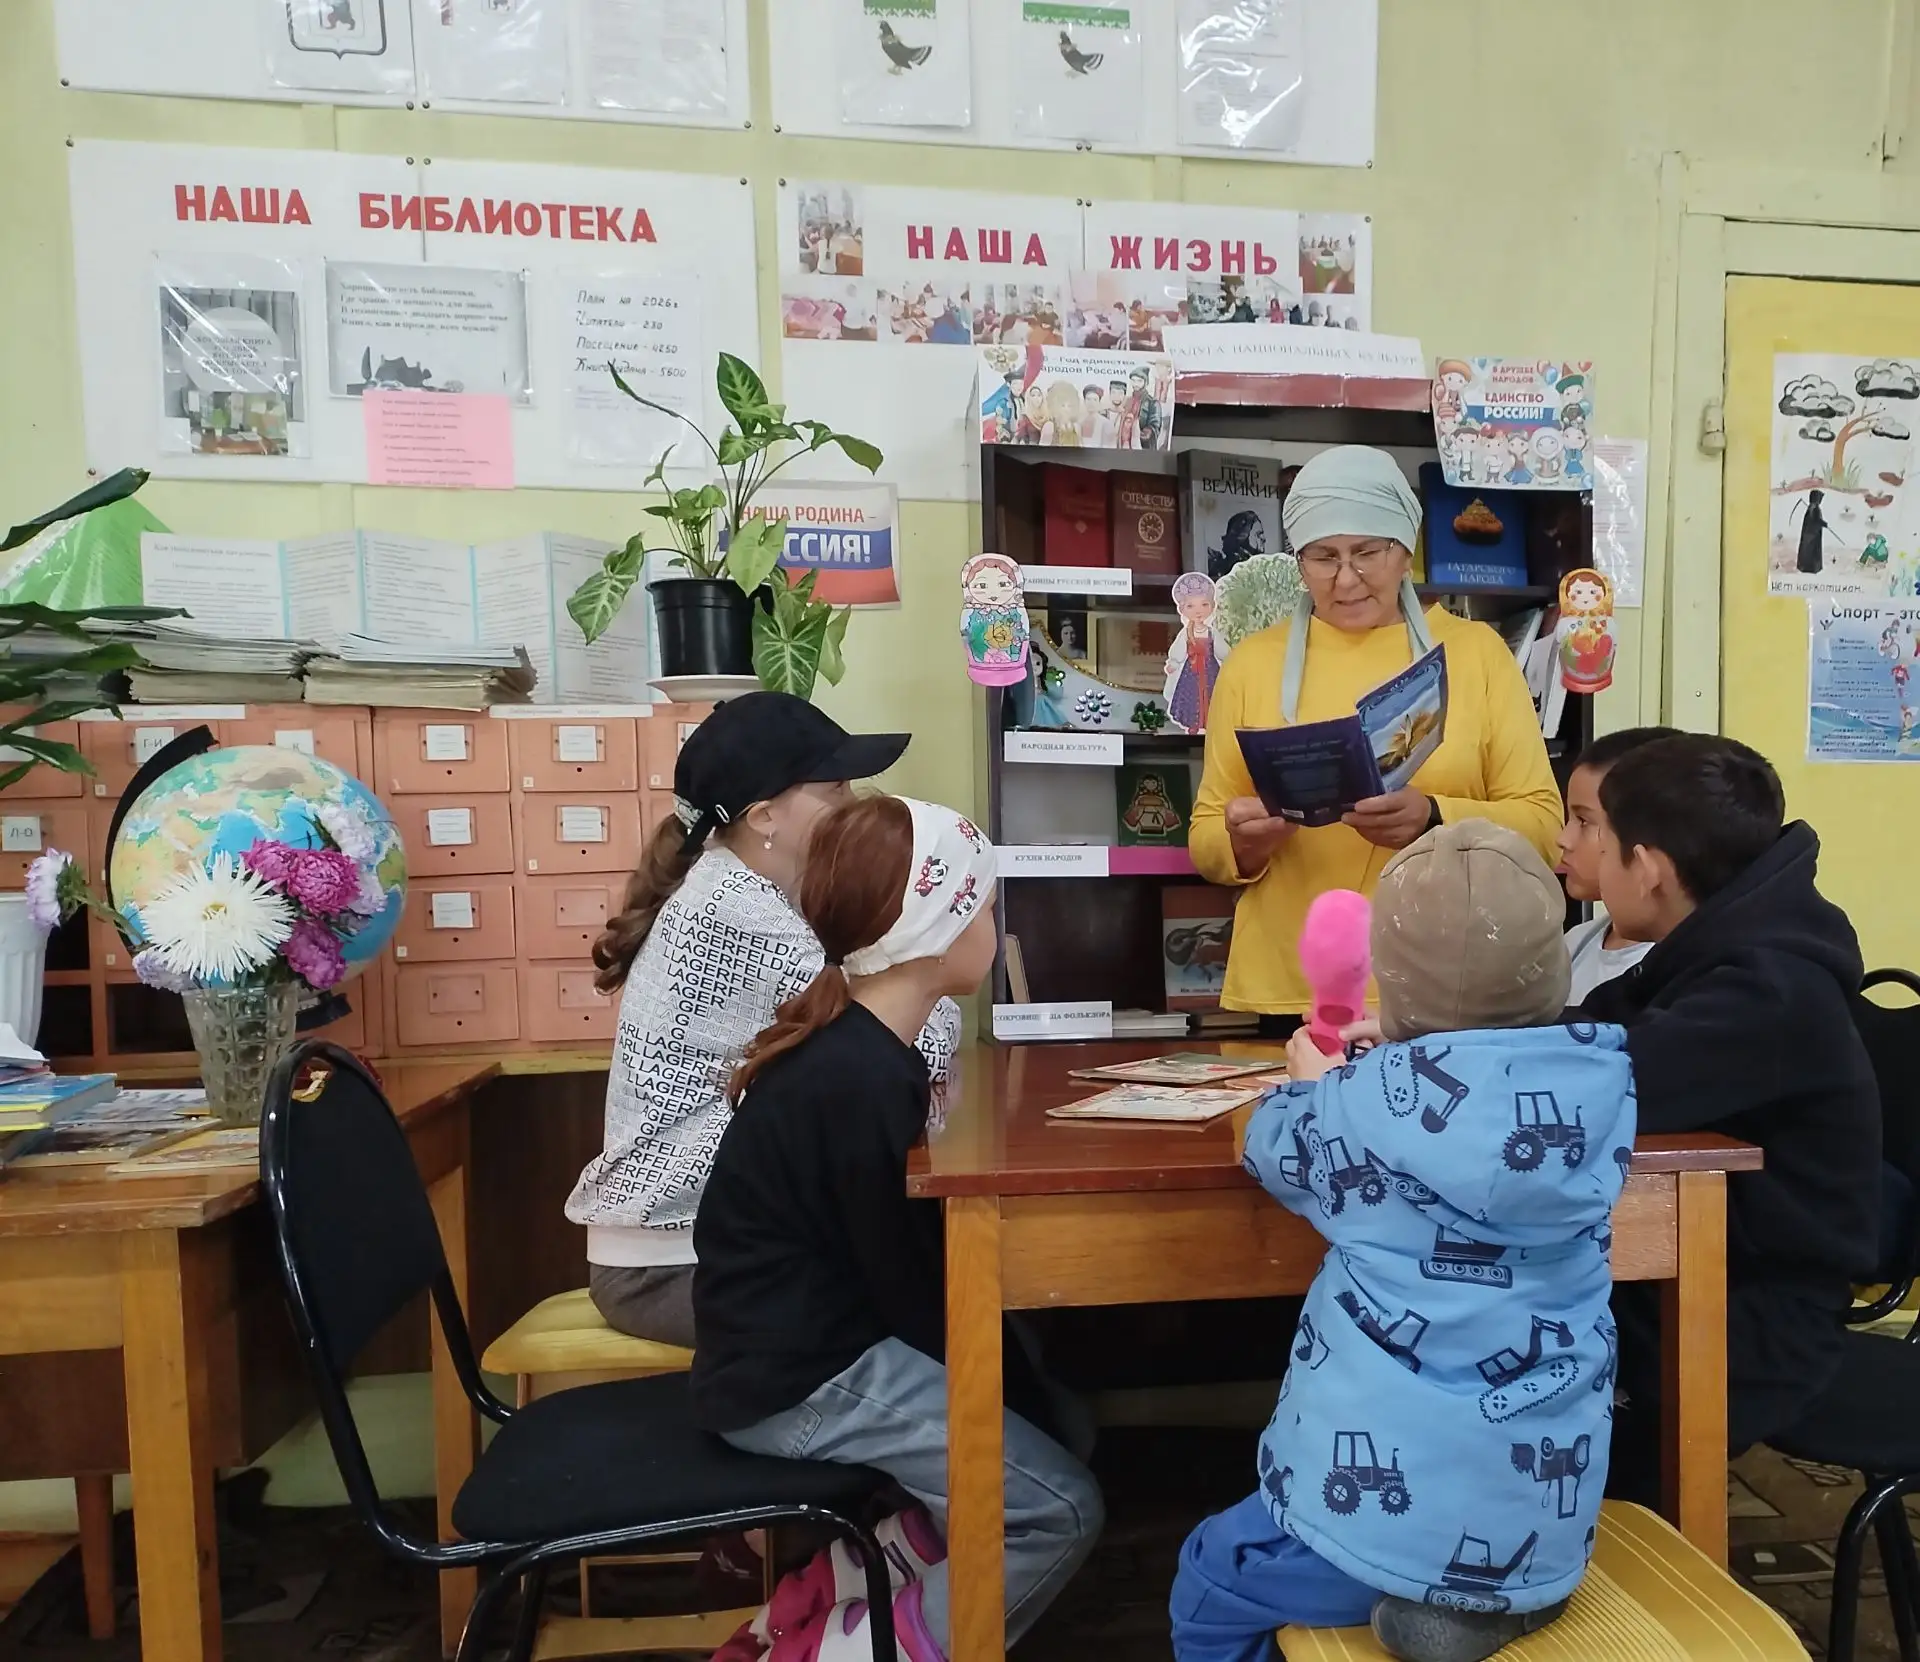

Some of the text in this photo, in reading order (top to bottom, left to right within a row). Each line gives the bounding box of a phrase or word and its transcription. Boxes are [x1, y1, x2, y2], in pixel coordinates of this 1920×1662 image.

[174, 184, 658, 243] НАША БИБЛИОТЕКА
[906, 225, 1278, 276] НАША ЖИЗНЬ
[577, 289, 605, 304] План
[618, 296, 632, 305] на
[576, 310, 625, 327] Читатели
[576, 336, 639, 352] Посещение
[652, 344, 679, 354] 4250
[1232, 344, 1351, 361] НАЦИОНАЛЬНЫХ
[575, 356, 646, 375] Книгоыдача
[660, 366, 687, 378] 5600
[1059, 355, 1080, 366] Год
[1082, 357, 1137, 367] единства
[1040, 365, 1127, 377] ародов России
[1499, 365, 1534, 375] ДРУЖБЕ
[1492, 375, 1534, 385] НАРОДОВ
[1485, 392, 1545, 404] ЕДИНСТВО
[1484, 406, 1544, 420] РОССИИ!
[795, 505, 865, 525] РОДИНА
[784, 532, 871, 564] ССИЯ!
[1057, 578, 1092, 586] РУССКОЙ
[1459, 574, 1505, 585] НАРОДА
[1831, 604, 1881, 622] Спорт
[1021, 743, 1108, 752] НАРОДНАЯ КУЛЬТУРА
[1014, 854, 1083, 862] КУХНЯ НАРОДОВ
[993, 1011, 1111, 1021] СОКРОВИЩЦА ФОЛЬКЛОРА
